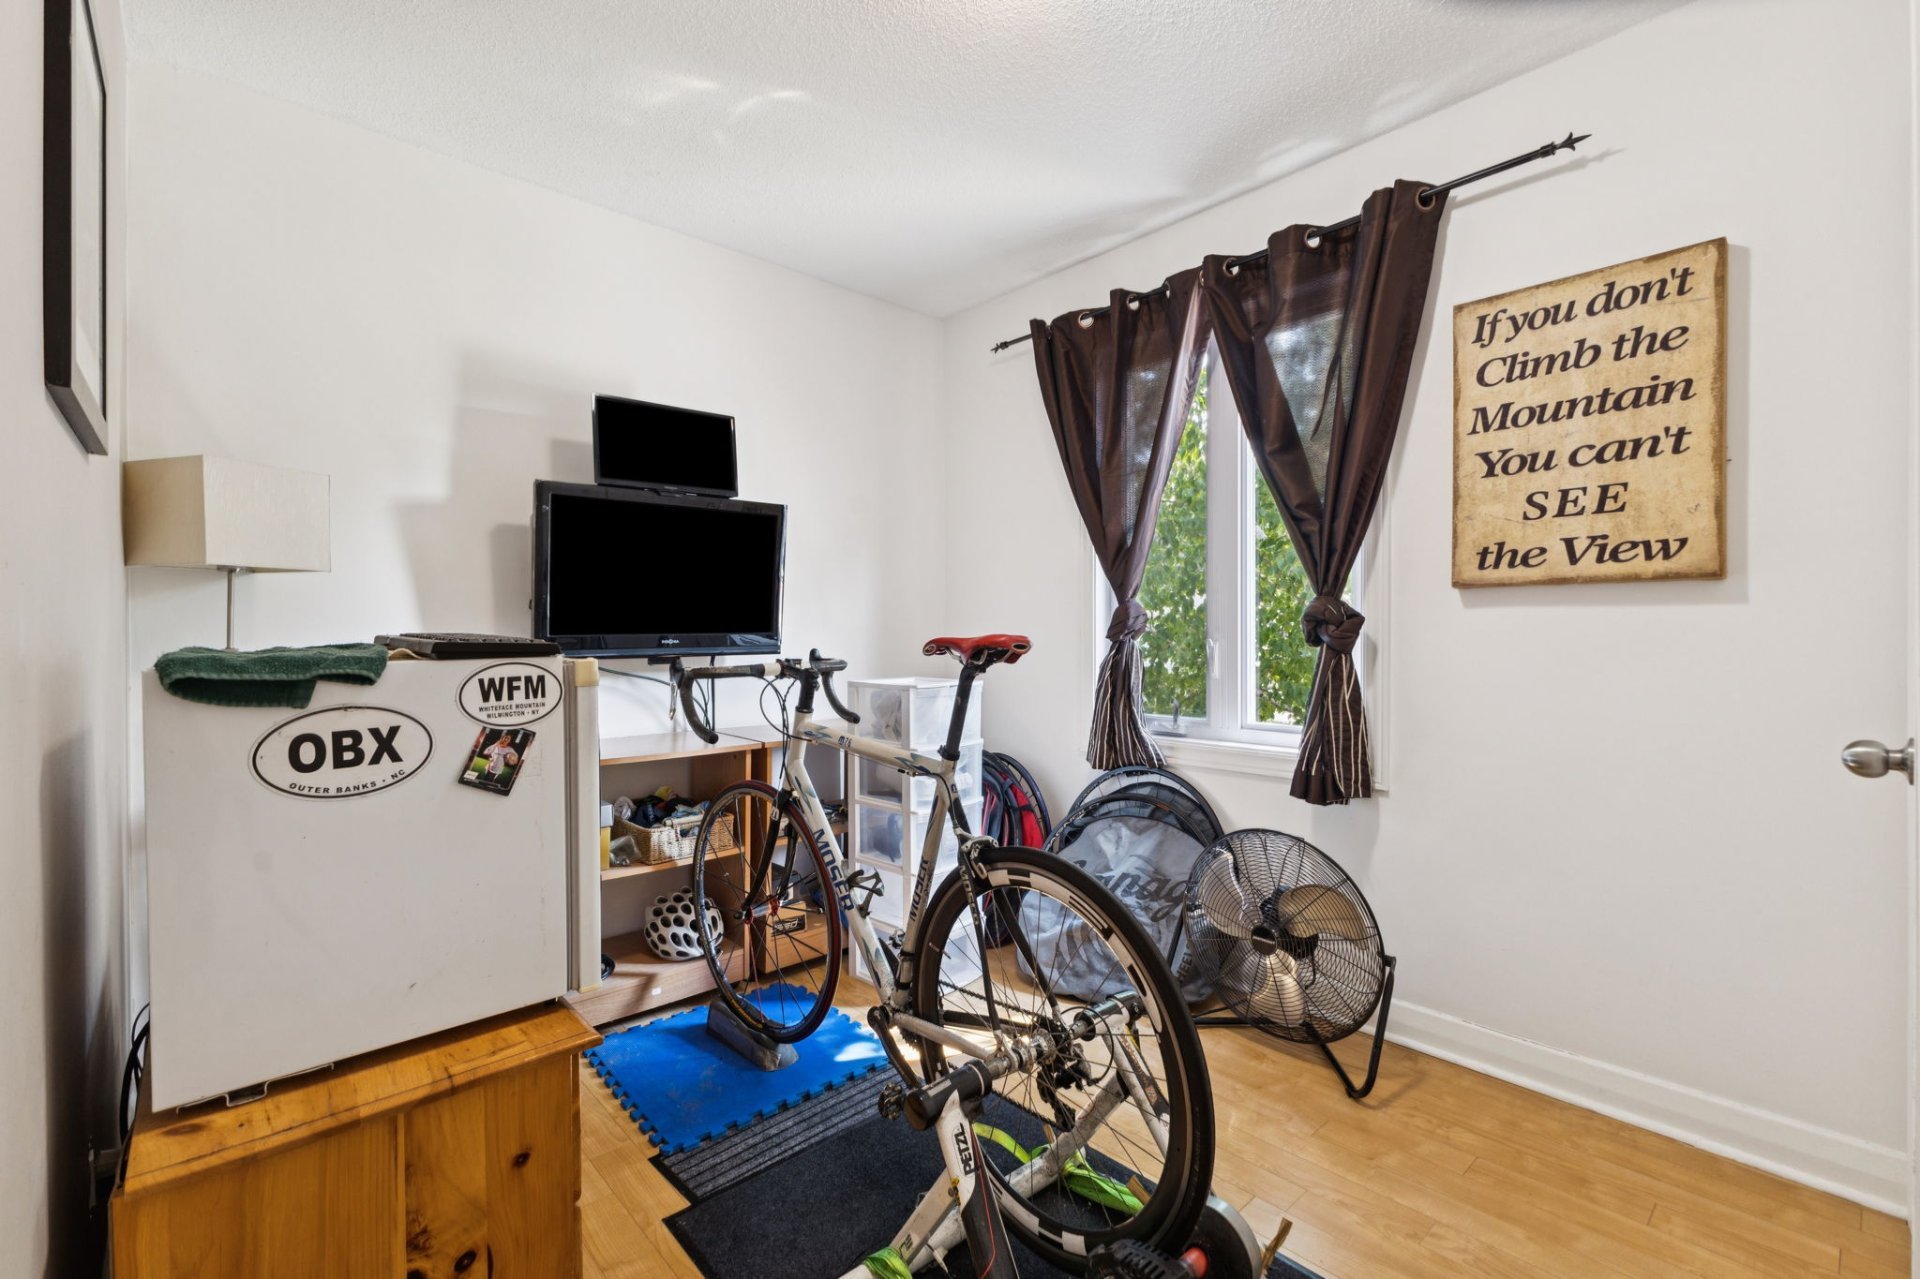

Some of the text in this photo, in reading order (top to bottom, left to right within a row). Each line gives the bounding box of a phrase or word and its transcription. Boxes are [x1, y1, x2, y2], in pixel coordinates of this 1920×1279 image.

[1471, 266, 1695, 349] If you don't
[1476, 325, 1690, 388] Climb the
[1467, 374, 1697, 436] Mountain
[1475, 426, 1692, 479] You can't
[1522, 482, 1629, 521] SEE
[1476, 534, 1689, 571] the View
[478, 674, 546, 703] WFM
[478, 702, 546, 712] WHITEFACE MOUNTAIN
[486, 711, 525, 719] WILMINGTON
[288, 725, 404, 774] OBX
[289, 769, 406, 794] OUTER BANKS NC
[812, 828, 855, 912] MOSER
[954, 1122, 977, 1176] PETZL
